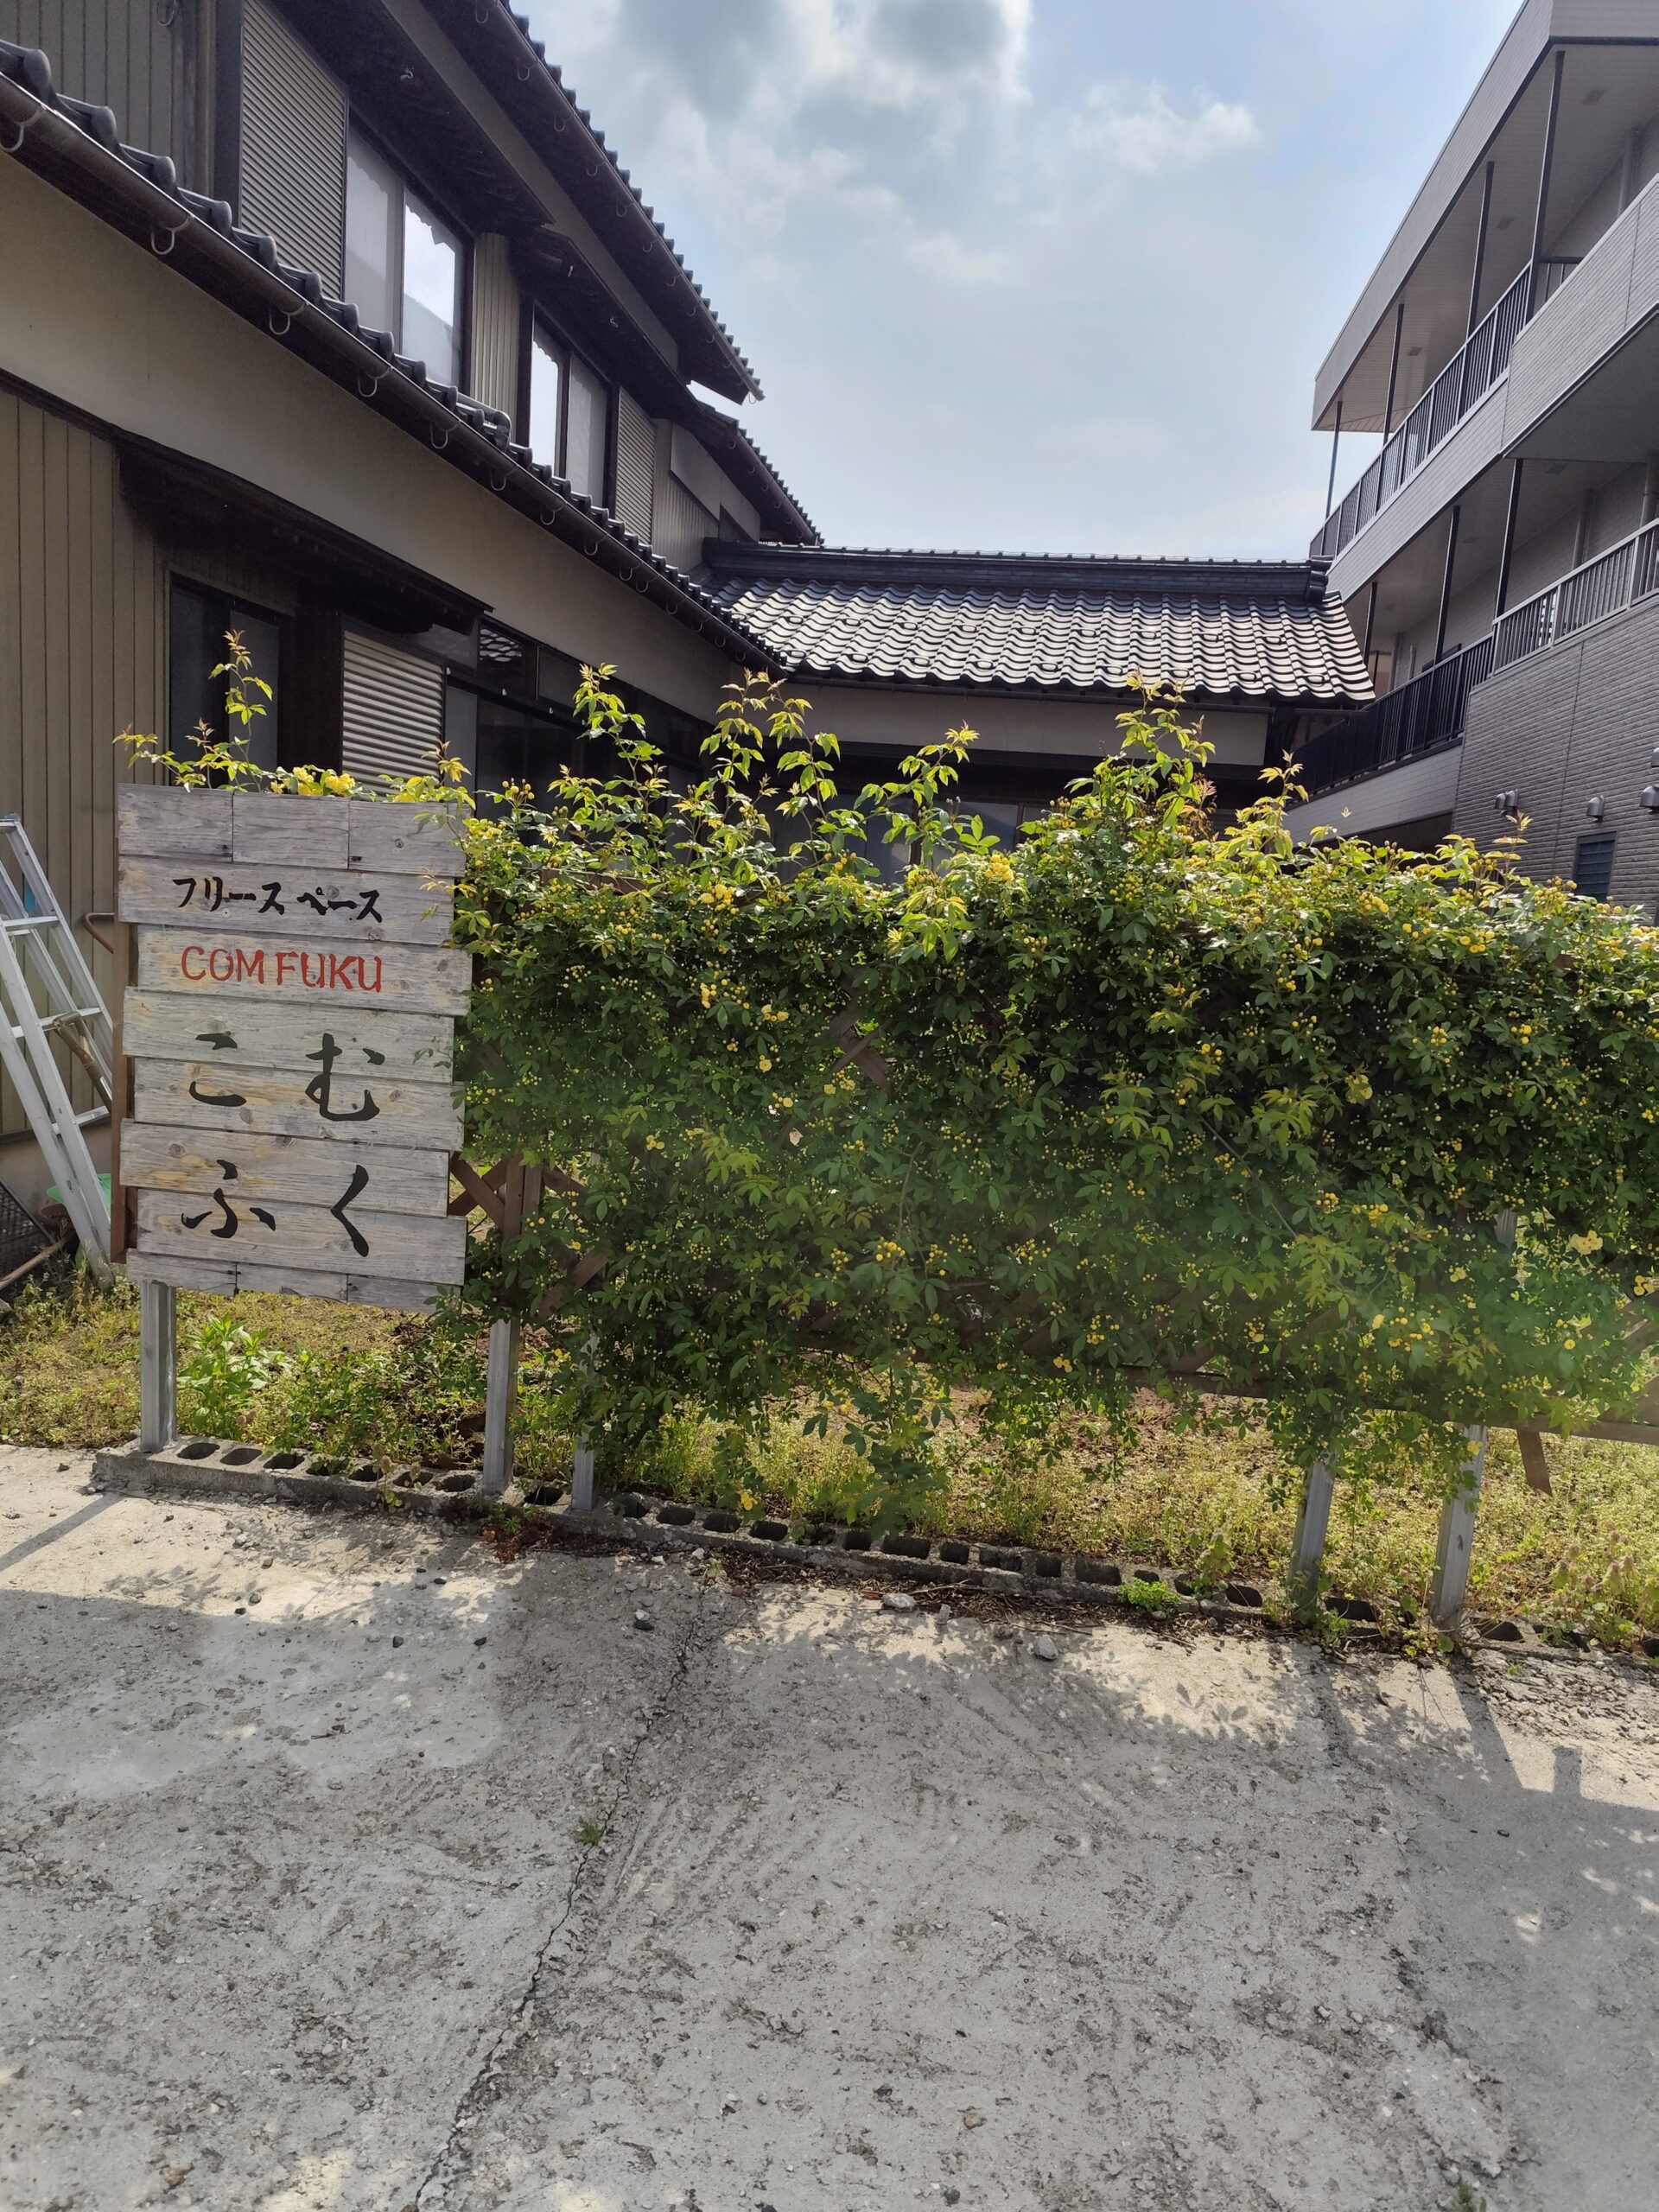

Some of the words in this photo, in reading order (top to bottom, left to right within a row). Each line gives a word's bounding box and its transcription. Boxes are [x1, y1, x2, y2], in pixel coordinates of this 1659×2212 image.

[172, 876, 383, 923] フリースペース
